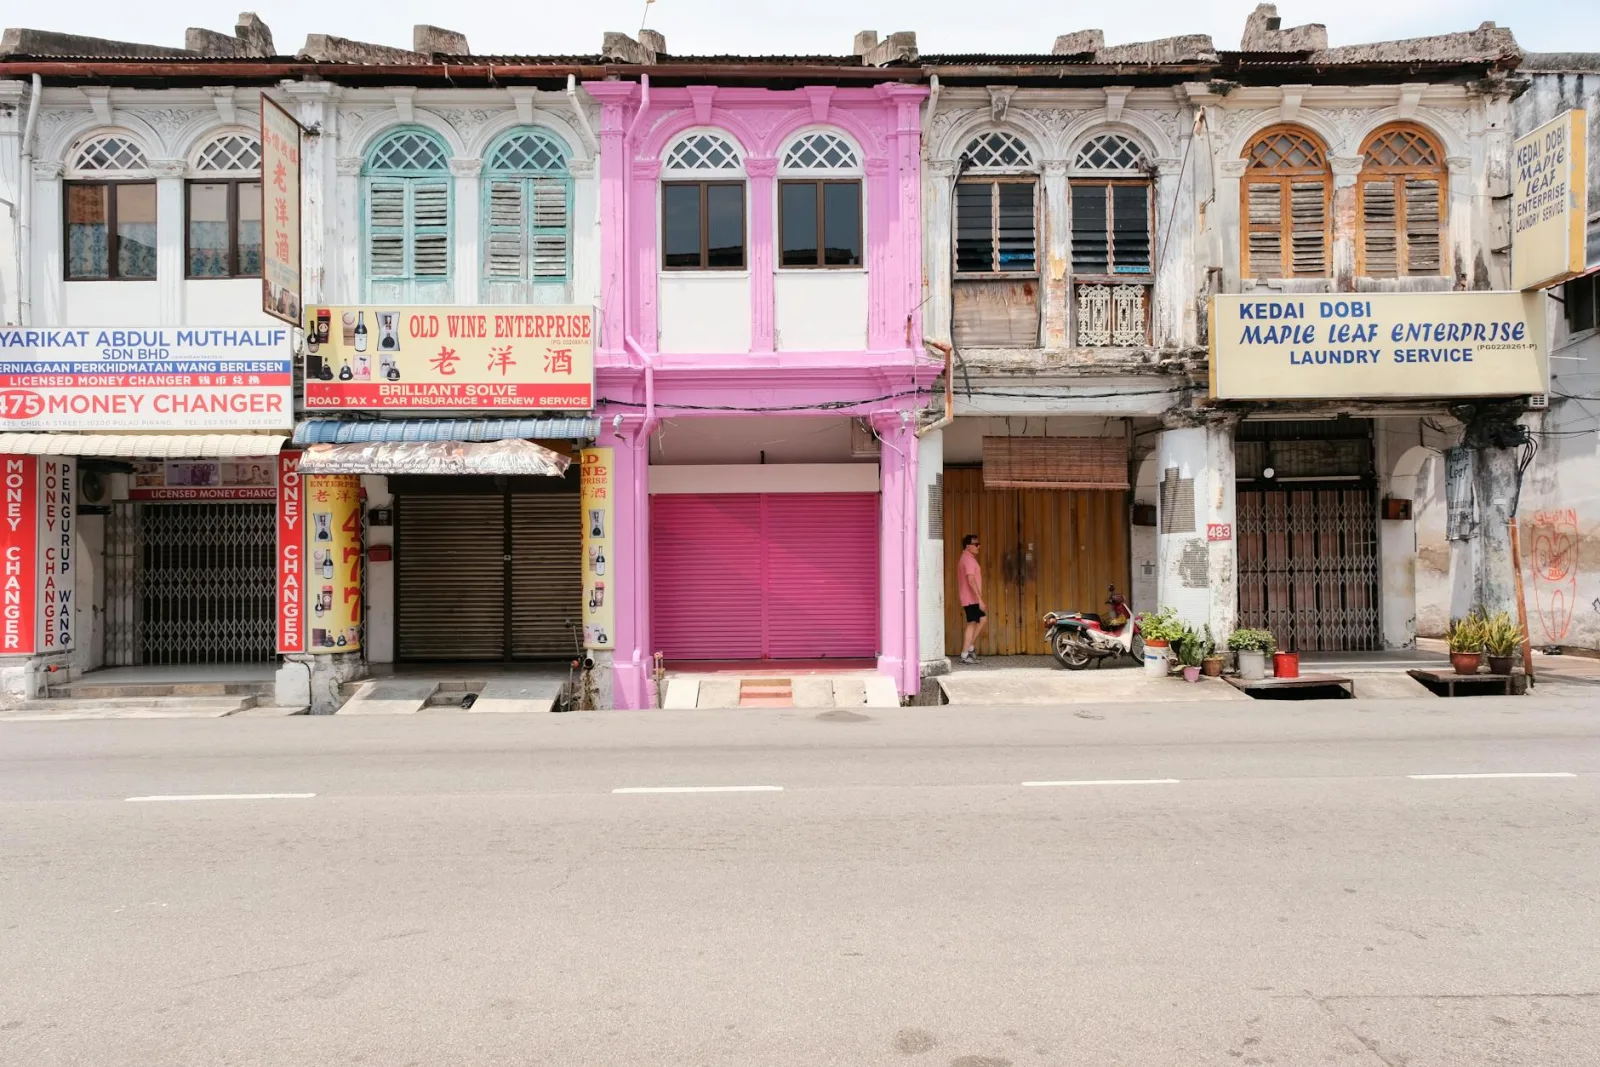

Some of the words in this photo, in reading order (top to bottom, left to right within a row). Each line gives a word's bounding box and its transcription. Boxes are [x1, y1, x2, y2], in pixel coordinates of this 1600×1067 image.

[1517, 138, 1540, 168] KEDAI
[1546, 124, 1565, 150] DOBI
[1518, 146, 1565, 184] MAPLE
[1526, 169, 1556, 197] LEAF
[1517, 182, 1565, 217] ENTERPRISE
[273, 160, 290, 265] 老洋酒
[1516, 213, 1540, 233] LAUNDRY
[1542, 199, 1564, 223] SERVICE
[1239, 303, 1304, 319] KEDAI
[1320, 301, 1371, 318] DOBI
[409, 315, 439, 338] OLD
[449, 315, 487, 338] WINE
[495, 314, 591, 338] ENTERPRISE
[1239, 324, 1315, 345] MAPLE
[1328, 323, 1379, 343] LEAF
[1391, 321, 1525, 343] ENTERPRISE
[0, 331, 90, 347] YARIKAT
[95, 331, 171, 347] ABDUL
[177, 330, 286, 347] MUTHALIF
[102, 348, 133, 360] SDN
[138, 348, 170, 360] BHD
[1290, 349, 1381, 365] LAUNDRY
[1393, 348, 1473, 363] SERVICE
[73, 362, 172, 373] PERKHIDMATAN
[176, 362, 216, 372] WANG
[219, 362, 284, 372] BERLESEN
[10, 376, 74, 386] LICENSED
[78, 376, 123, 386] MONEY
[128, 376, 192, 386] CHANGER
[379, 385, 460, 396] BRILLIANT
[465, 385, 517, 396] SOLVE
[0, 394, 40, 415] 475
[48, 394, 146, 414] MONEY
[153, 393, 283, 414] CHANGER
[308, 397, 340, 405] ROAD
[345, 397, 367, 405] TAX
[383, 397, 407, 405] CAR
[411, 396, 478, 405] INSURANCE
[493, 396, 533, 405] RENEW
[540, 396, 588, 405] SERVICE
[6, 459, 24, 532] MONEY
[45, 462, 56, 532] MONEY
[151, 490, 197, 499] LICENSED
[199, 490, 236, 498] MONEY
[283, 458, 298, 530] MONEY
[60, 464, 71, 575] PENGURUP
[1208, 525, 1231, 538] 483
[4, 547, 22, 649] CHANGER
[45, 548, 56, 647] CHANGER
[283, 545, 299, 647] CHANGER
